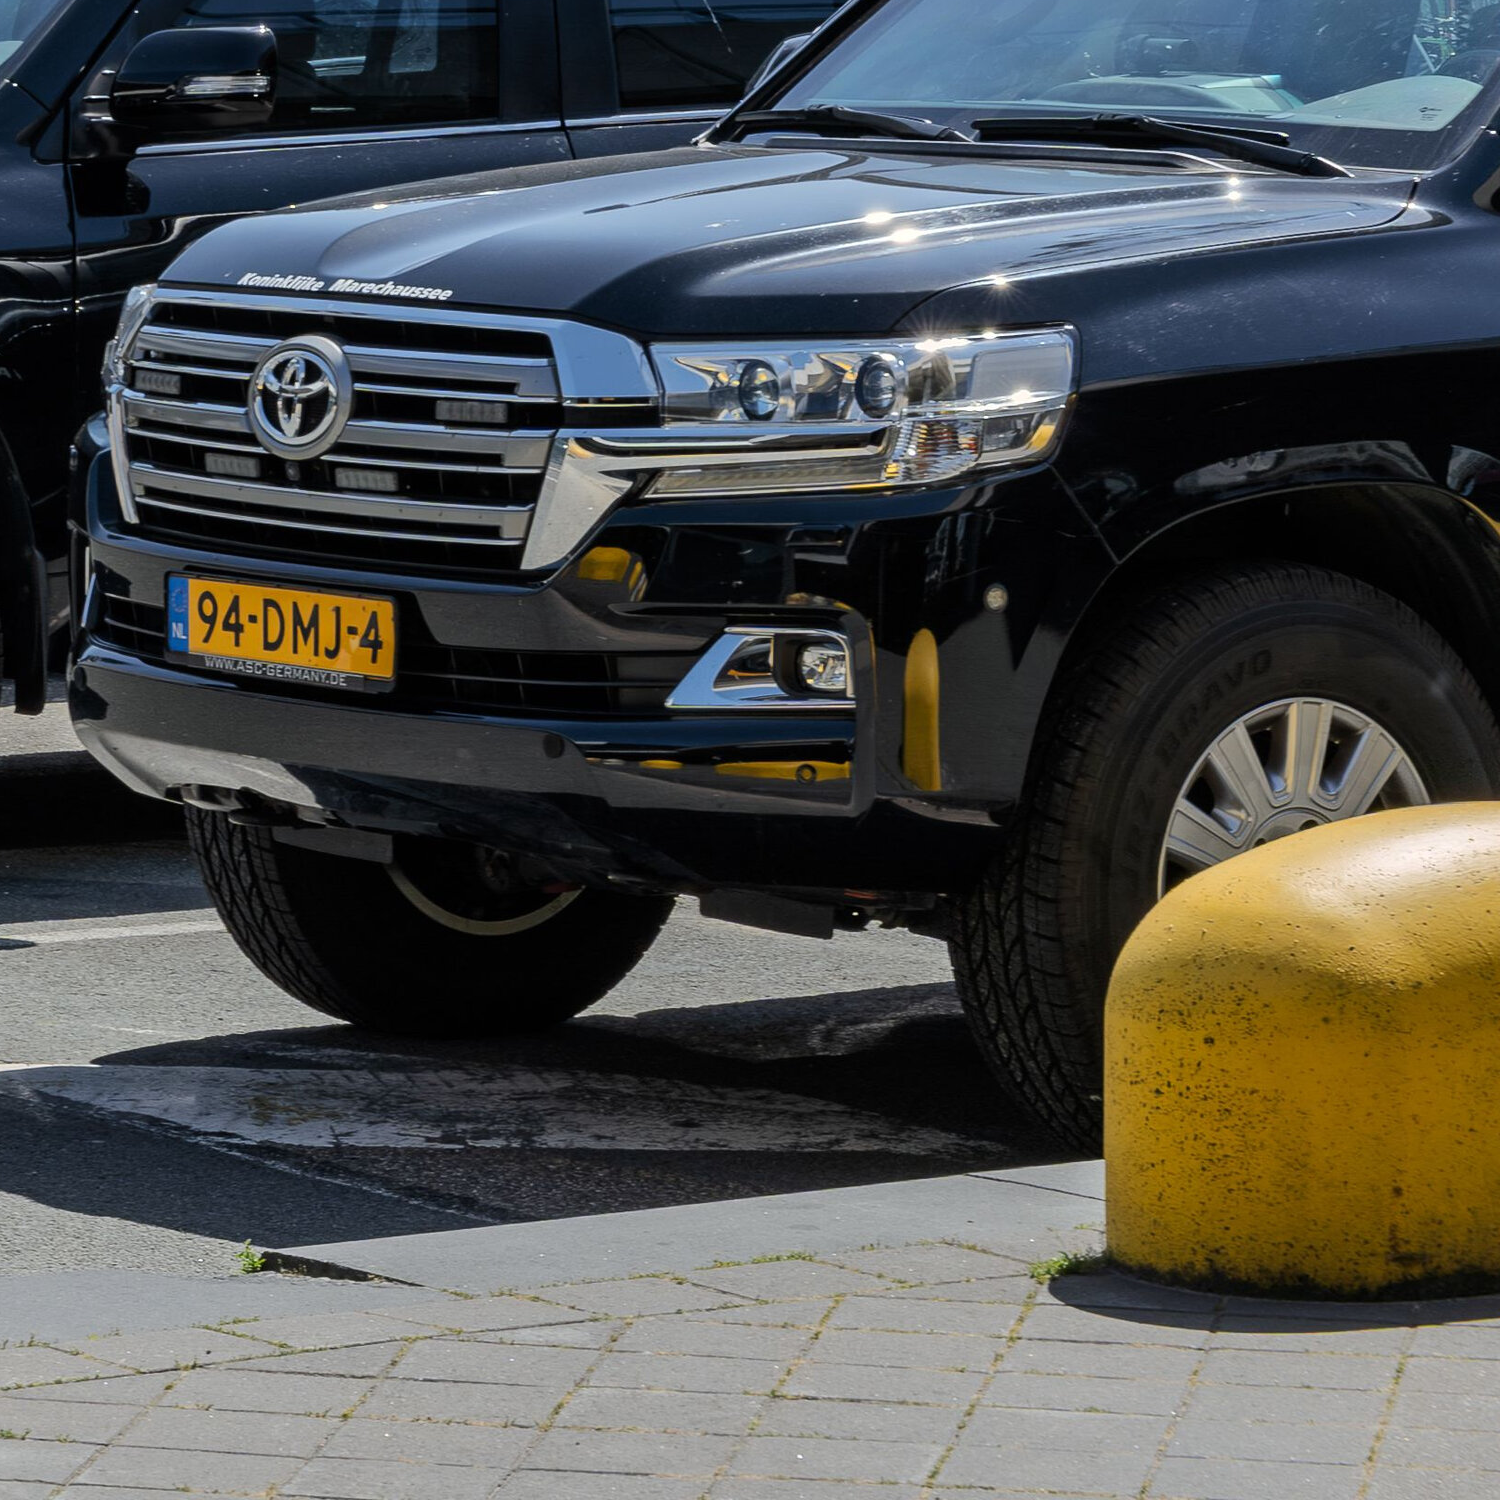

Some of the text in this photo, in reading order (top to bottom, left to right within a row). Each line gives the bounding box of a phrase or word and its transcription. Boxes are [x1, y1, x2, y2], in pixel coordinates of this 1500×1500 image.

[237, 272, 454, 301] Koninklijke Marechaussee
[171, 621, 188, 640] NL
[197, 590, 383, 665] 94-DMJ-4
[204, 654, 348, 687] WWW.ASC-GERMANY.DE
